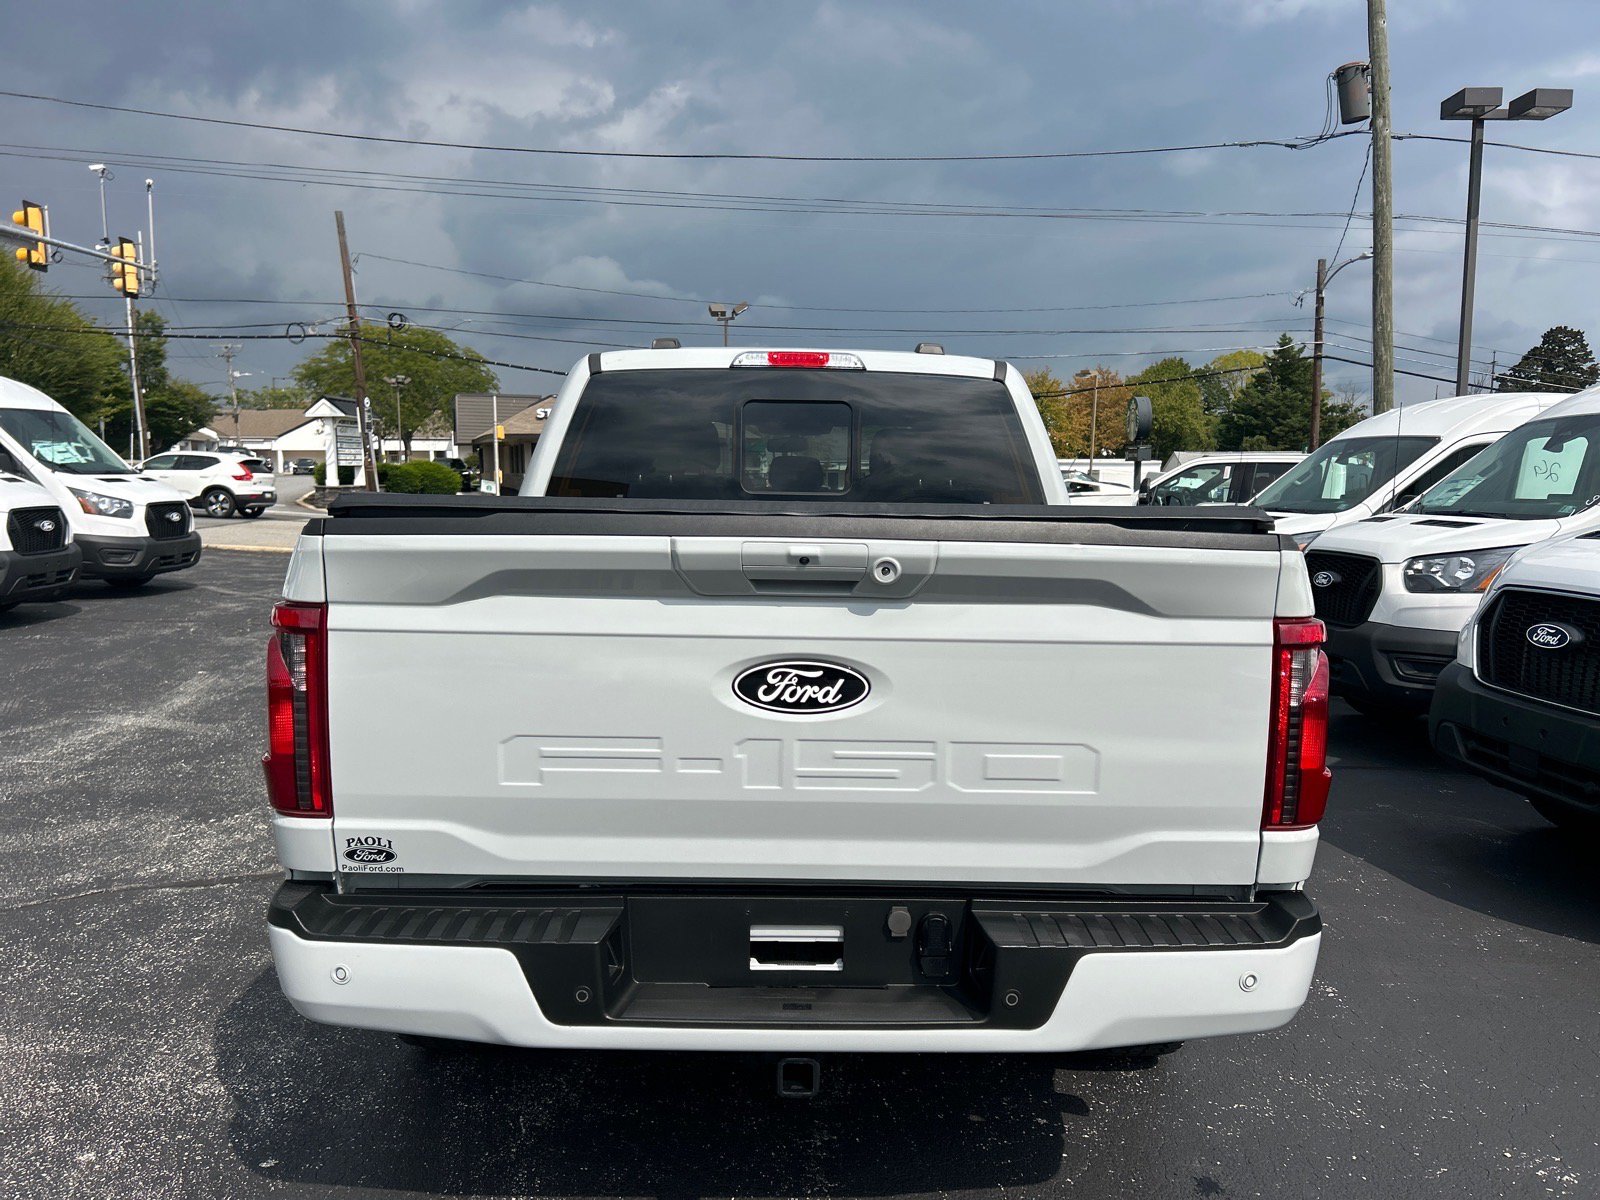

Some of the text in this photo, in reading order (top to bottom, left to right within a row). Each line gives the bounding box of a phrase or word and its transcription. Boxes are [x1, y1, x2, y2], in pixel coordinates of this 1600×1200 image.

[1532, 626, 1562, 645] Ford
[757, 667, 845, 704] Ford
[499, 734, 1100, 794] F-150
[345, 835, 394, 850] PAOLI
[353, 848, 387, 862] Ford
[341, 864, 405, 873] PaoliFord.com
